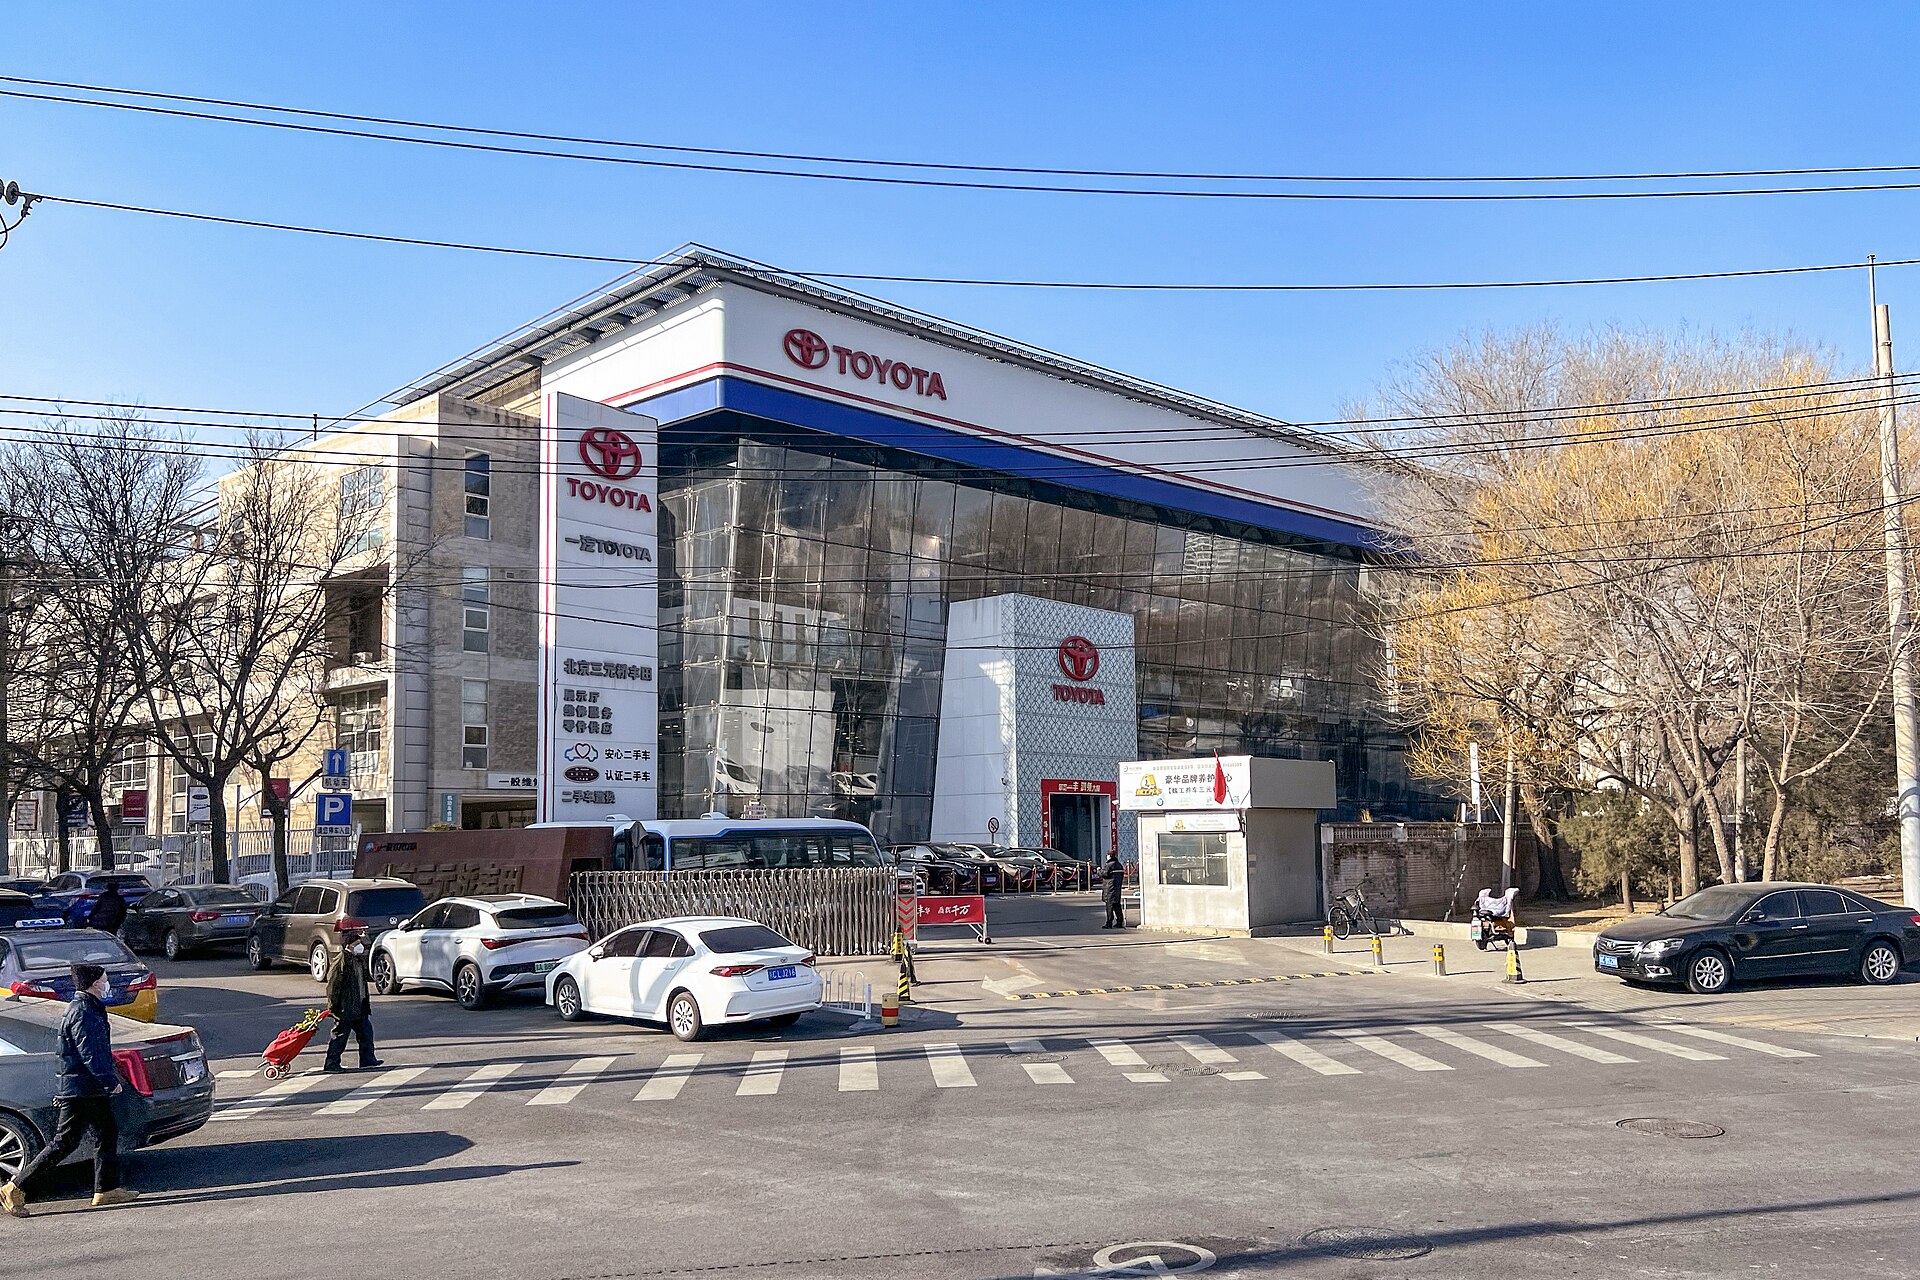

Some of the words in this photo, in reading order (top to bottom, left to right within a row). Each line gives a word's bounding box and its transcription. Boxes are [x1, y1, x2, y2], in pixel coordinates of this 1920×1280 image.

[832, 345, 947, 400] TOYOTA
[566, 477, 652, 512] TOYOTA
[563, 658, 653, 681] 北京三元桥丰田
[563, 689, 600, 703] 展示厅
[1051, 684, 1105, 705] TOYOTA
[563, 704, 613, 719] 维修服务
[563, 719, 613, 734] 零件供应
[604, 748, 651, 761] 安心二手车
[325, 777, 348, 787] 机动车
[604, 770, 651, 782] 认证二手车
[1165, 773, 1233, 785] 豪华品牌养护心
[561, 790, 616, 804] 二手车置换
[324, 797, 345, 822] P
